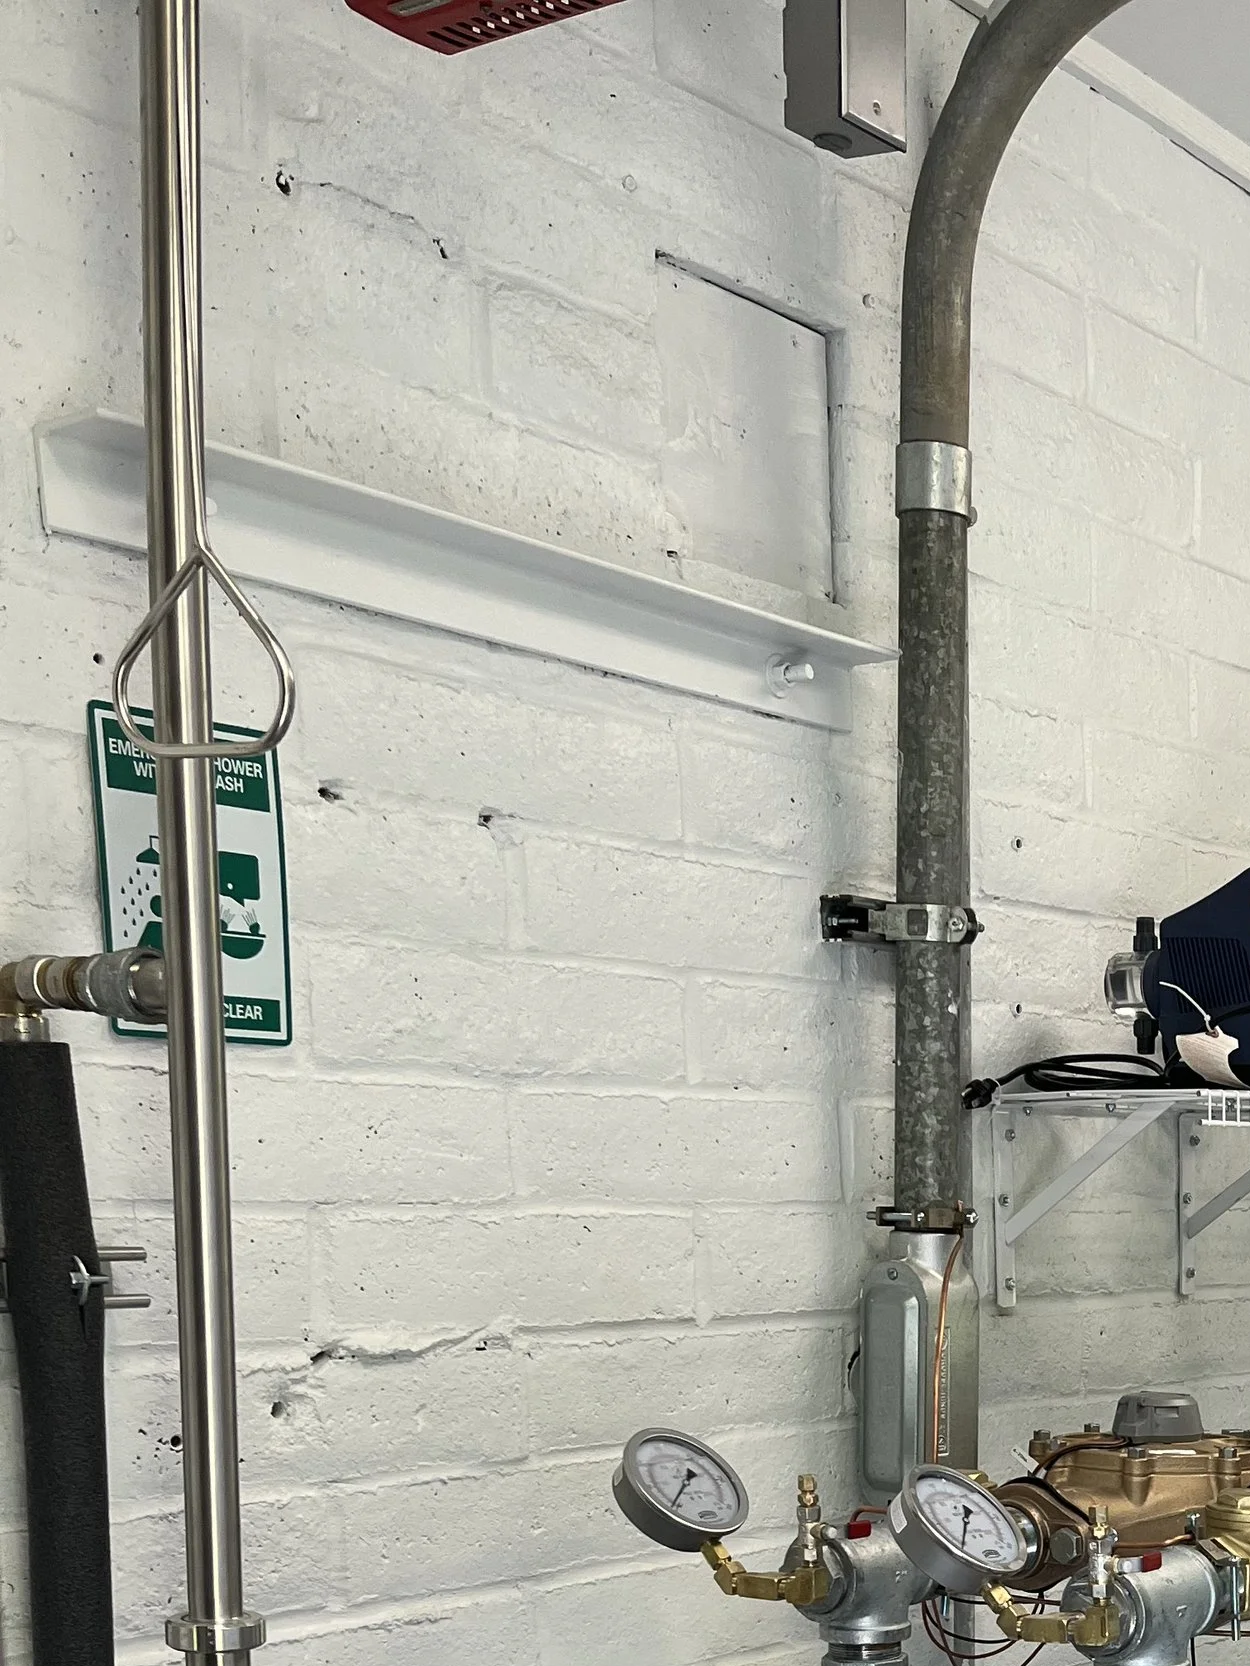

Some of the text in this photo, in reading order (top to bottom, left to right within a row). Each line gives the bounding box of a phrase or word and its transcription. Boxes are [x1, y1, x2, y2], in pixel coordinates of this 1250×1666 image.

[109, 738, 264, 779] EMER HOWER
[215, 774, 244, 794] ASH
